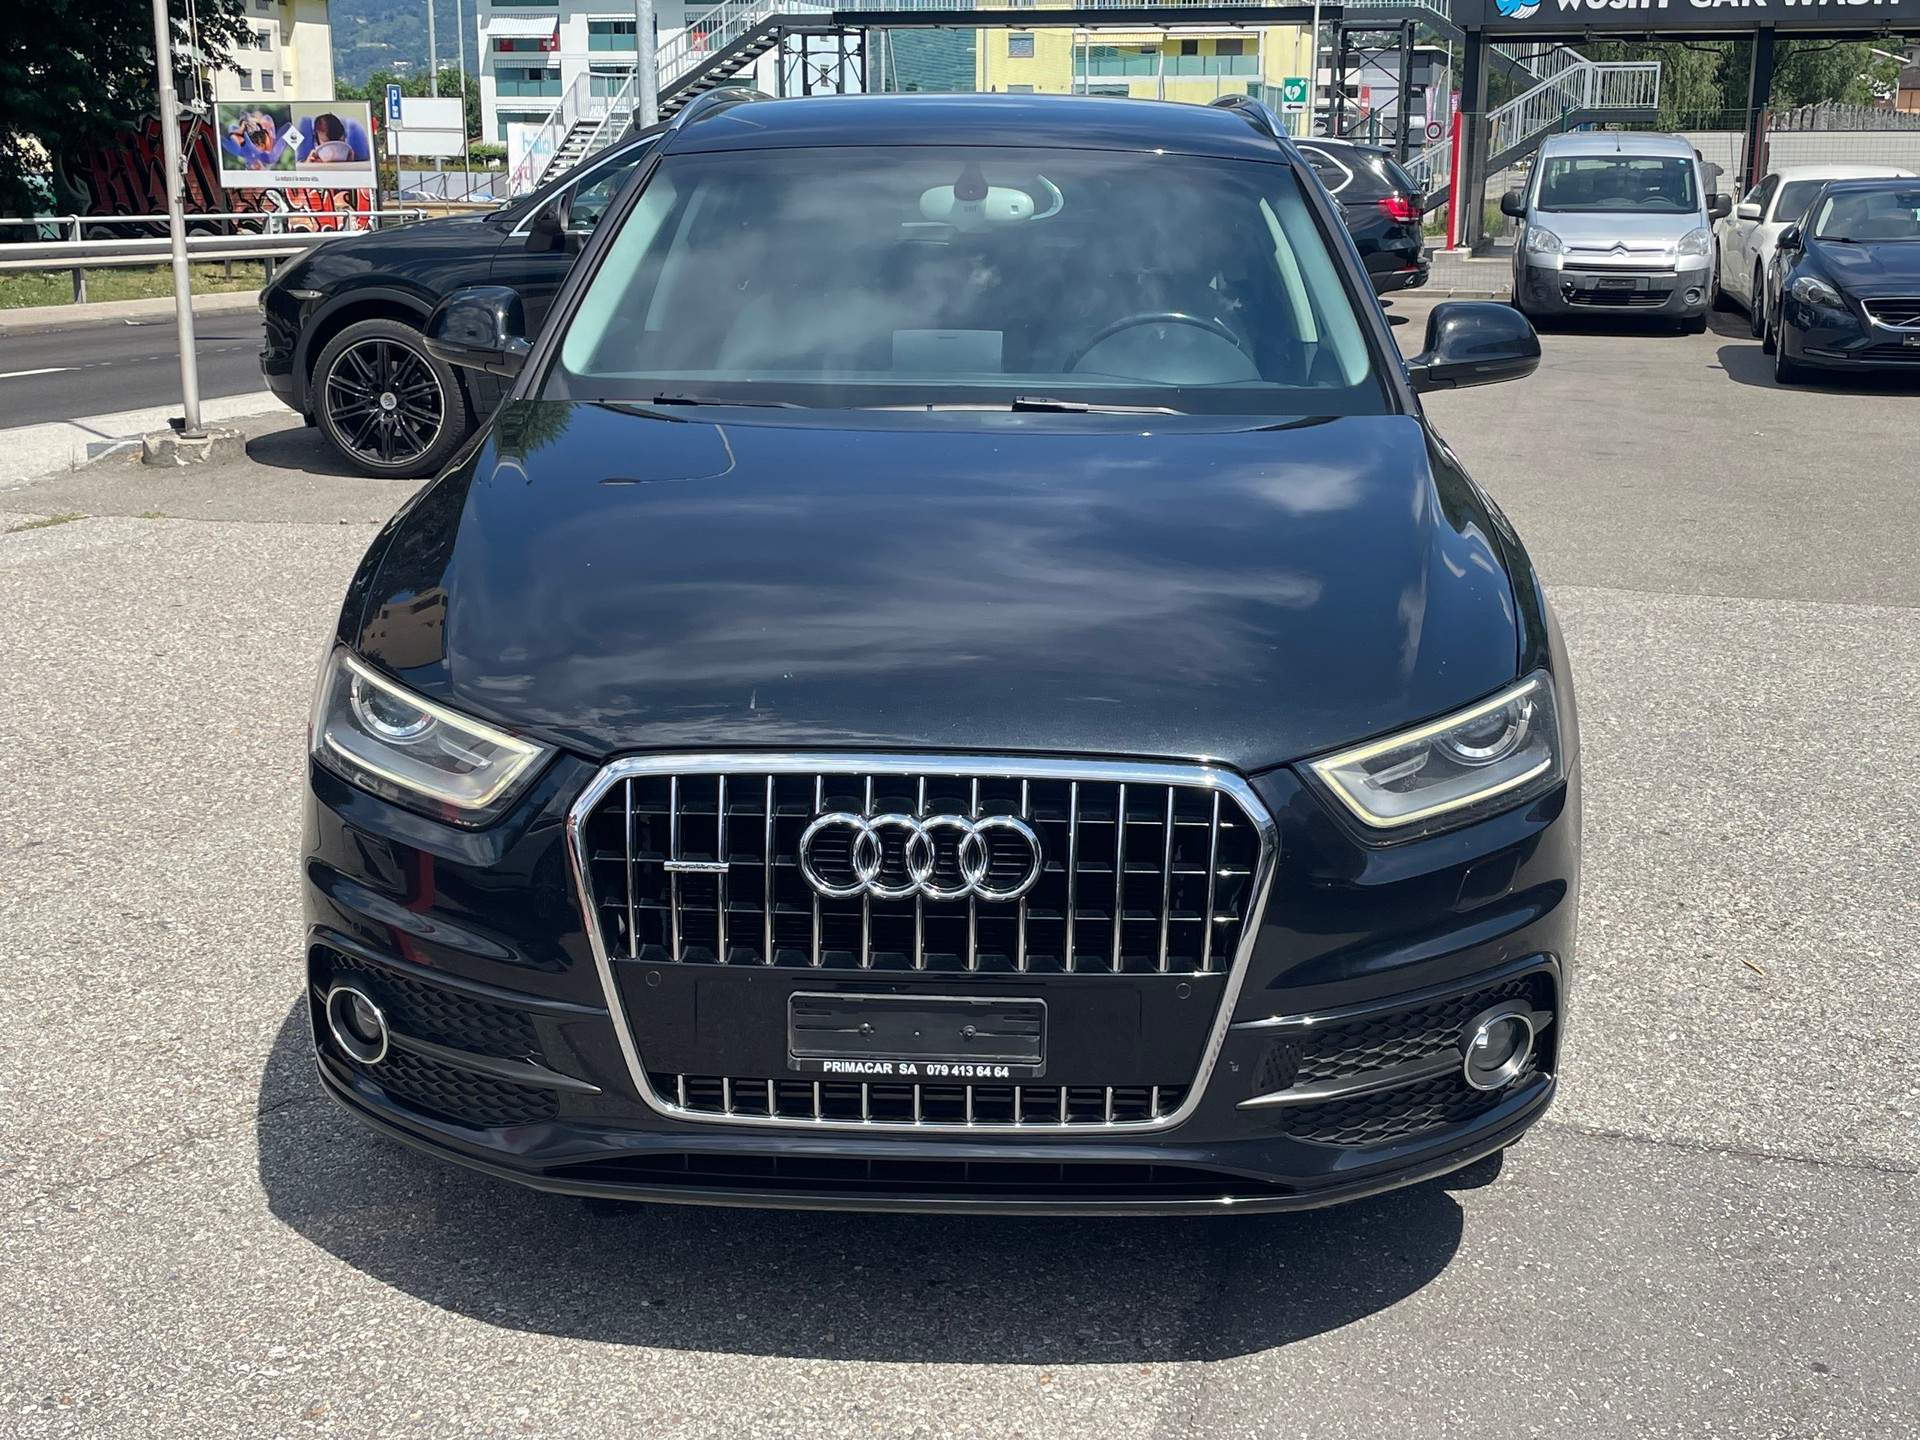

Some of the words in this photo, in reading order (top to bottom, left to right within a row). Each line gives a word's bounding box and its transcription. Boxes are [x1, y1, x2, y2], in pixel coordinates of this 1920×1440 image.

[823, 1061, 893, 1074] PRIMACAR
[899, 1062, 918, 1075] SA
[926, 1064, 949, 1076] 079
[950, 1064, 973, 1077] 413
[976, 1065, 991, 1077] 64
[994, 1066, 1009, 1078] 64
